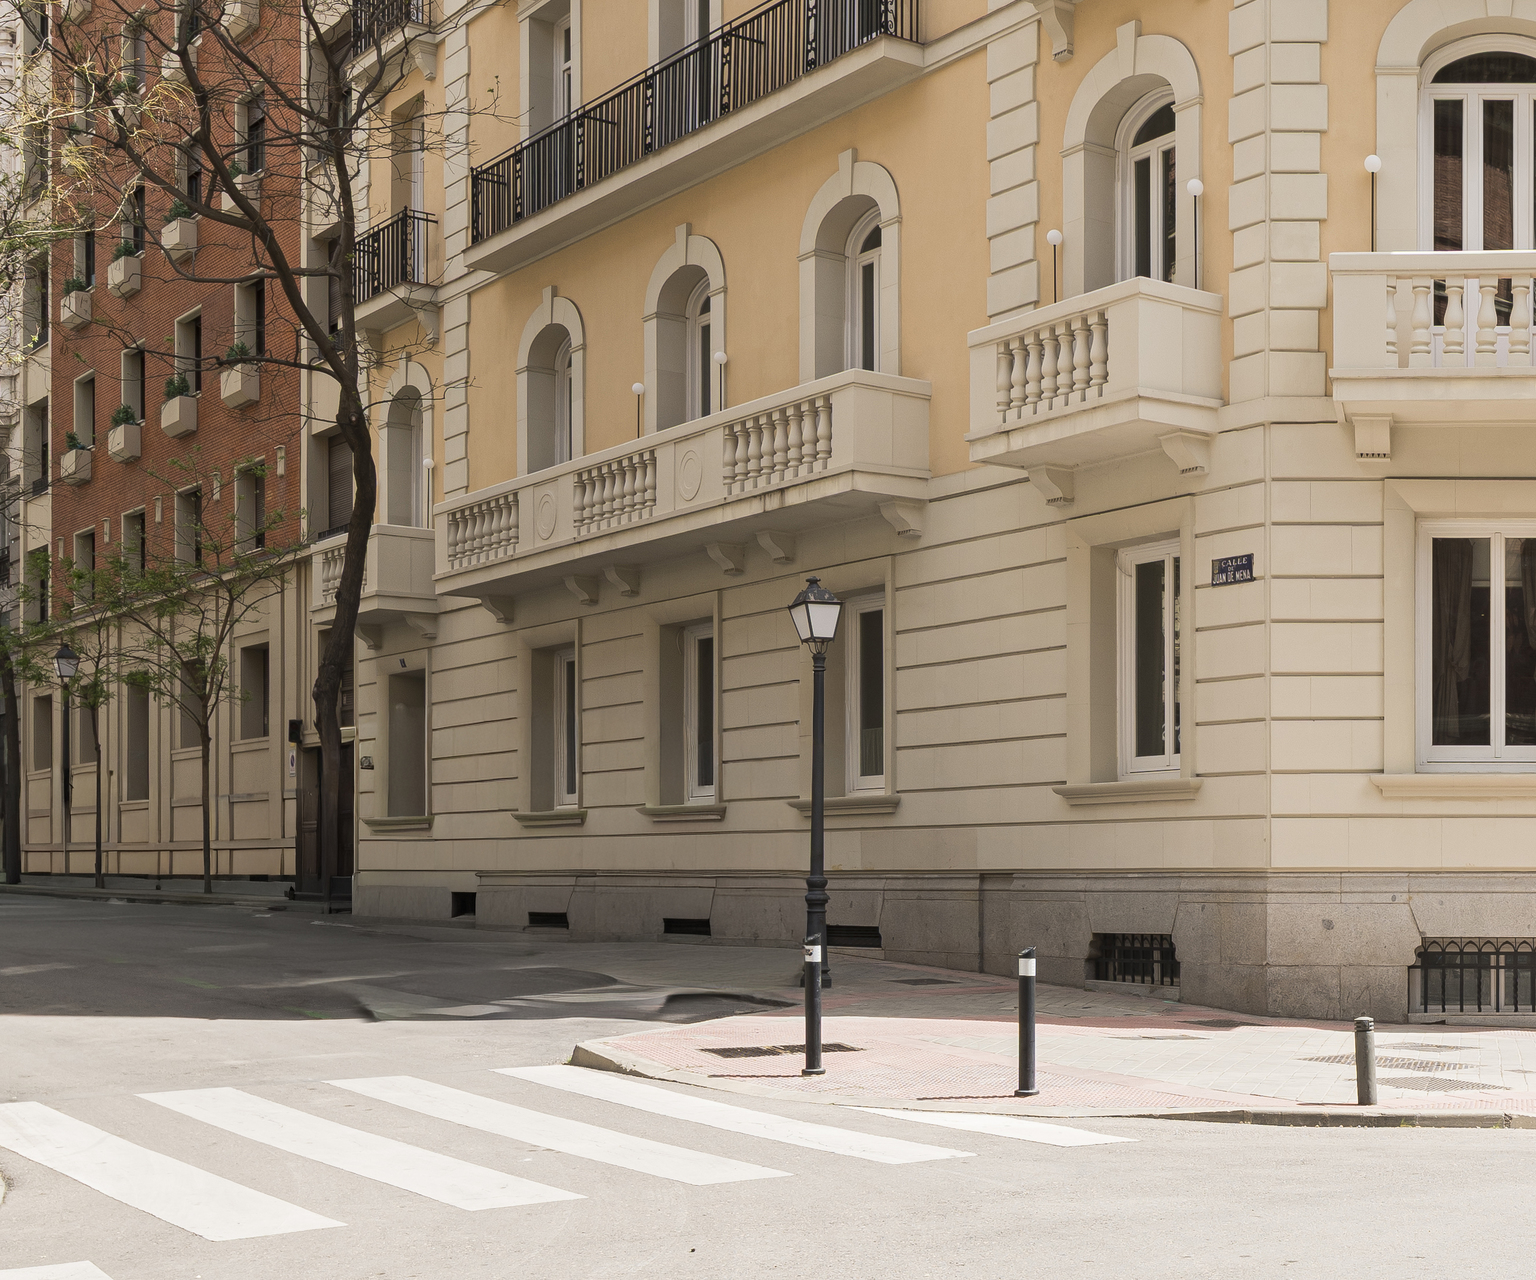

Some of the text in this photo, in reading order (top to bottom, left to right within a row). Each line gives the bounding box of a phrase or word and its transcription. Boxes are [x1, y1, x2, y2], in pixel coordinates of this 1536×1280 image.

[1222, 557, 1247, 567] CALLE
[1213, 569, 1251, 584] JUAN DE MENA
